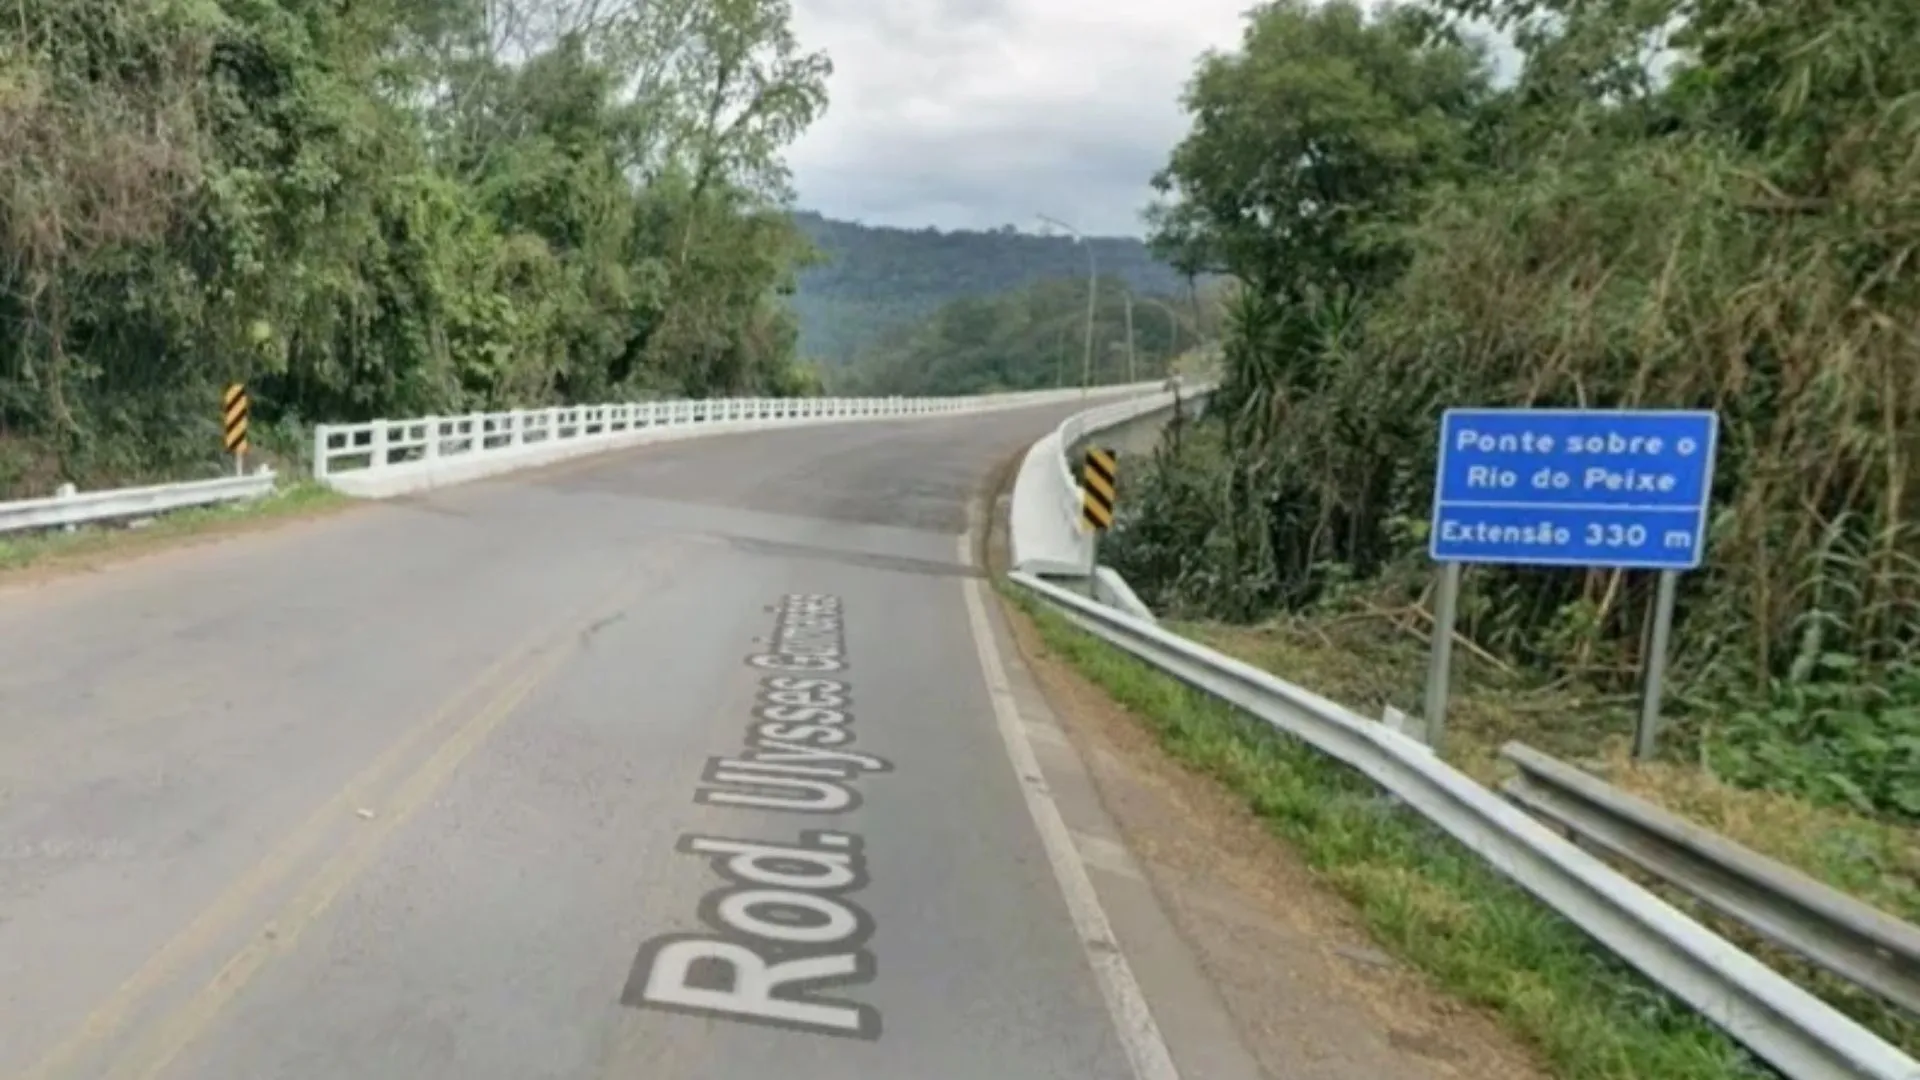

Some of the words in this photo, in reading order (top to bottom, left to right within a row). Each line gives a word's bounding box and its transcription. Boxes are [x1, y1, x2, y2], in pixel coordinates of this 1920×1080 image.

[1456, 429, 1554, 452] Ponte
[1566, 432, 1663, 455] sobre
[1676, 437, 1697, 456] o
[1467, 465, 1518, 488] Rio
[1530, 467, 1571, 489] do
[1583, 468, 1677, 492] Peixe
[1440, 520, 1571, 545] Extensão
[1585, 523, 1647, 547] 330
[1663, 530, 1691, 548] m
